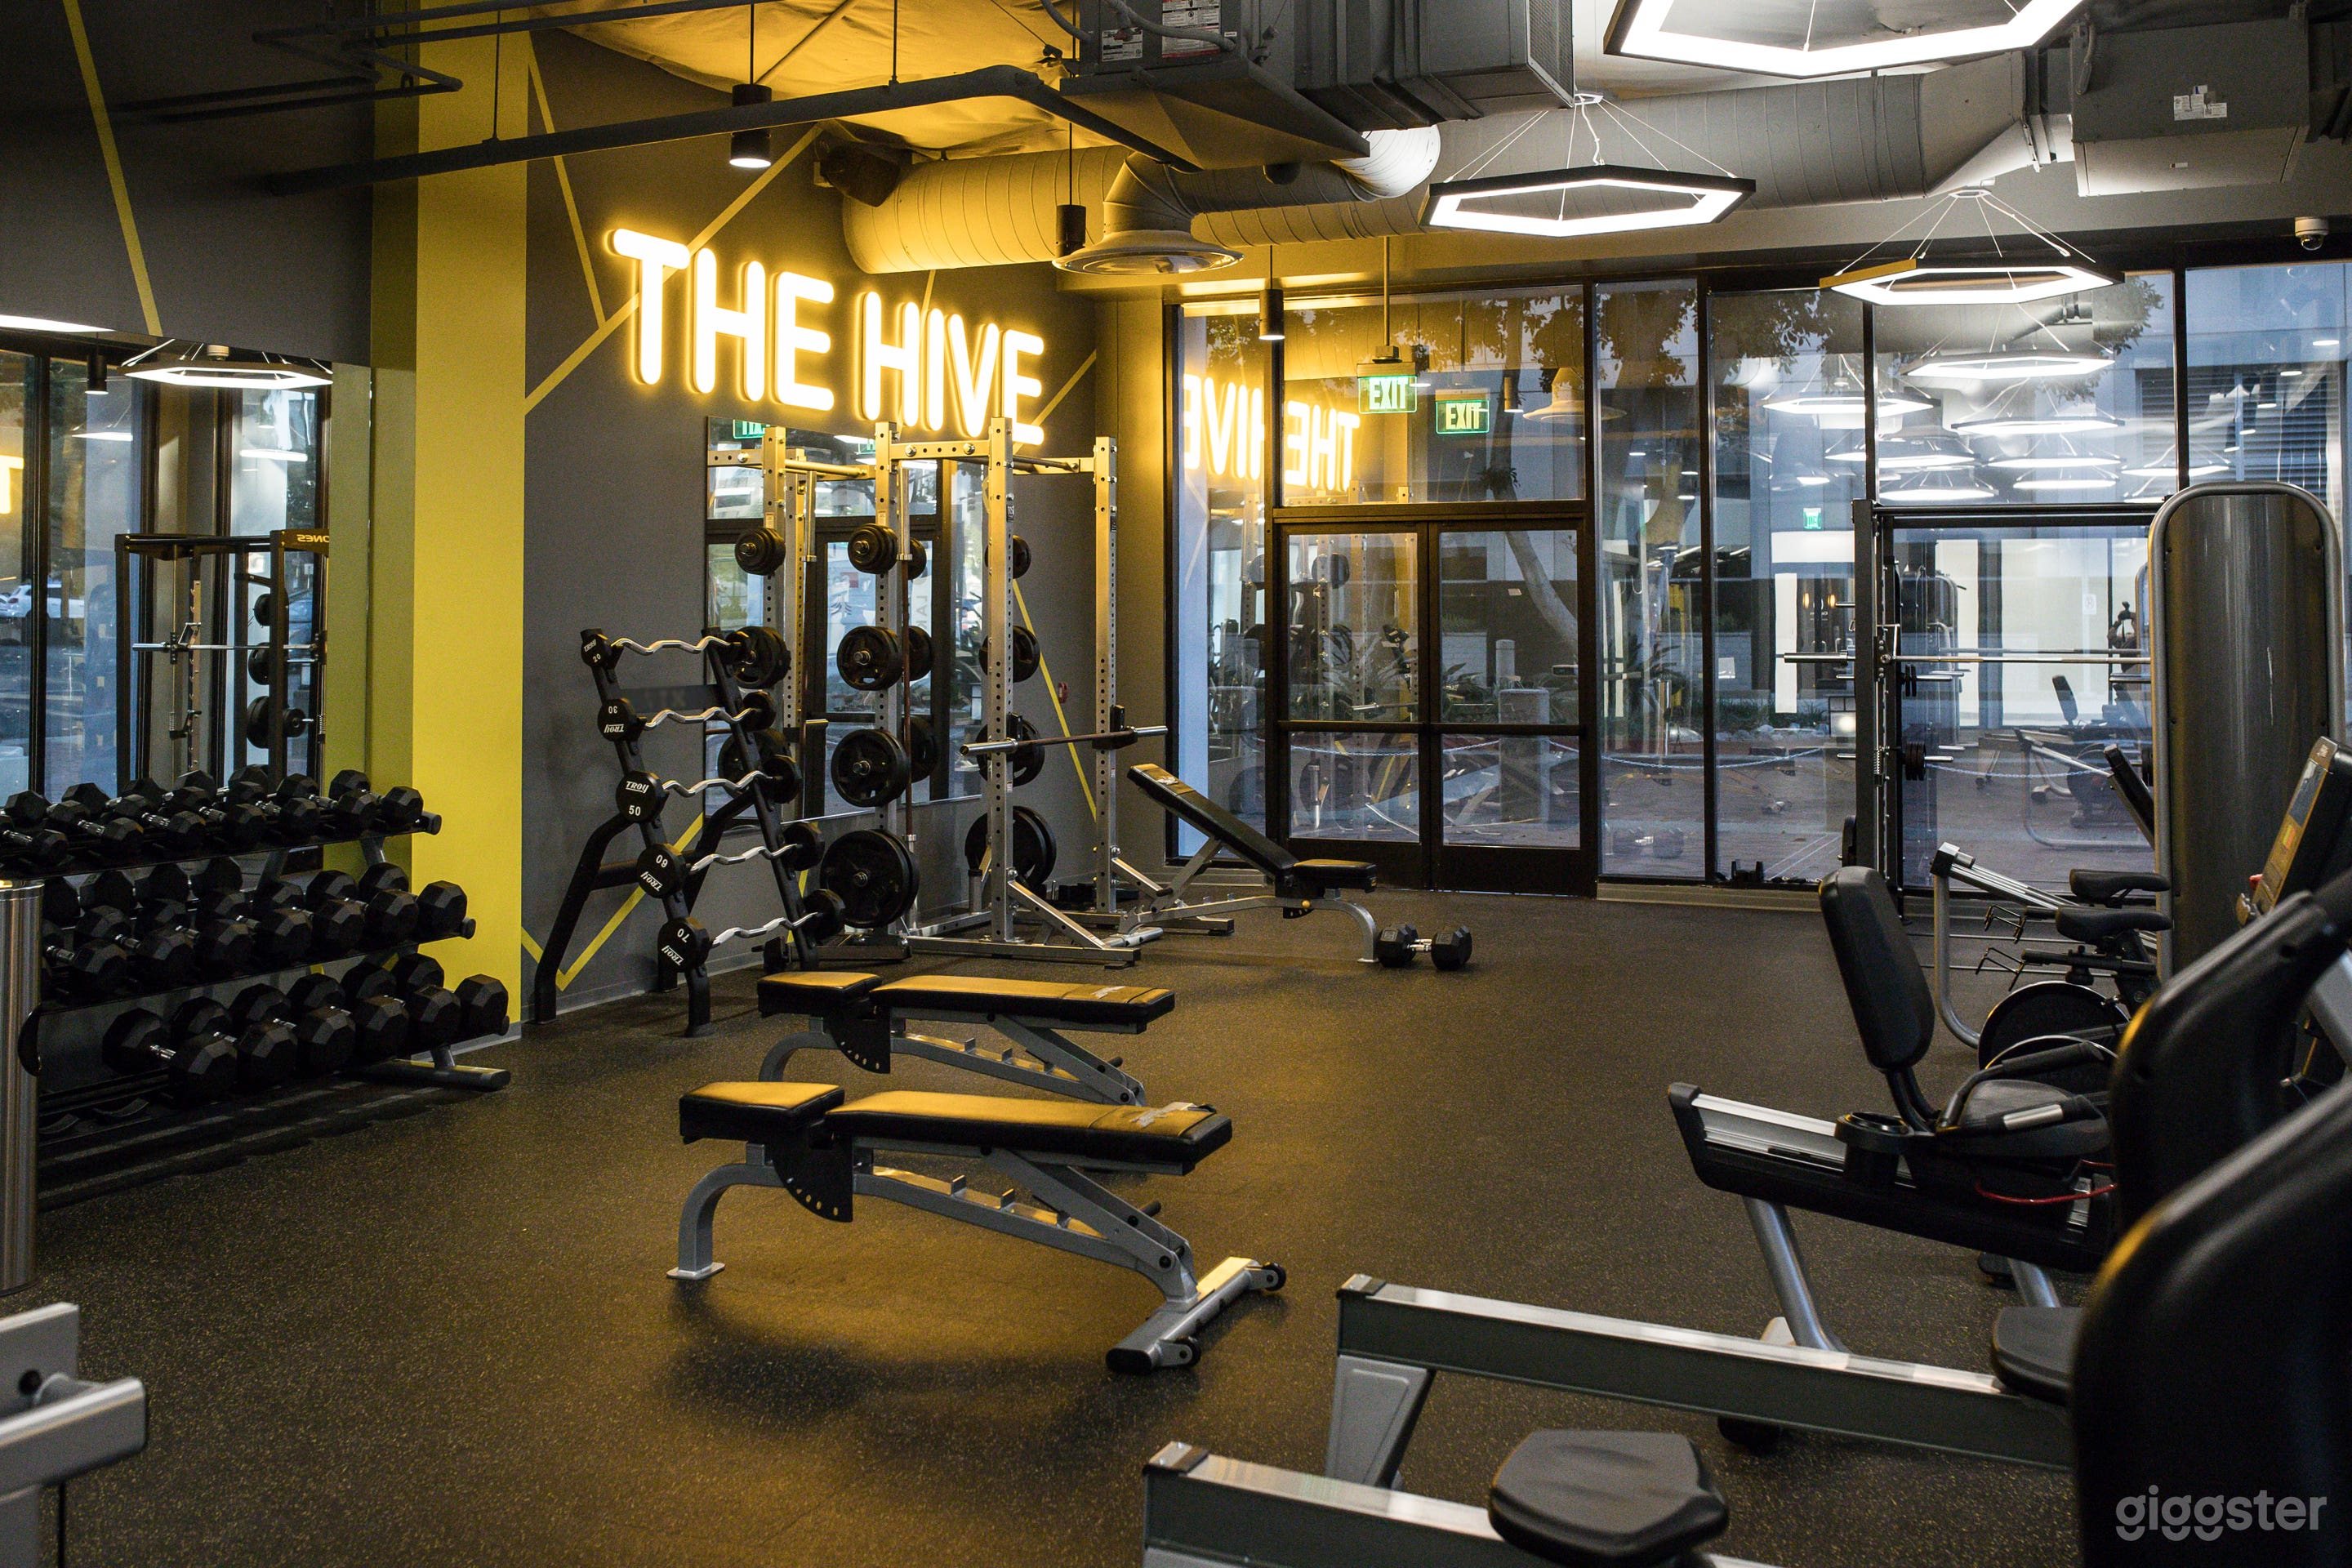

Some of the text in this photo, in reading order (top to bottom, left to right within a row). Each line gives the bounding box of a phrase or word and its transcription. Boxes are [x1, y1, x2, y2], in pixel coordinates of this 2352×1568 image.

[613, 228, 1045, 446] THE HIVE
[1369, 377, 1409, 410] EXIT
[1446, 402, 1482, 430] EXIT
[592, 653, 601, 663] 20
[608, 706, 618, 714] 30
[604, 724, 625, 733] TROY
[626, 781, 649, 794] TROY
[629, 804, 641, 816] 50
[656, 854, 668, 868] 60
[640, 871, 663, 892] TROY
[677, 928, 690, 943] 70
[661, 945, 684, 966] TROY
